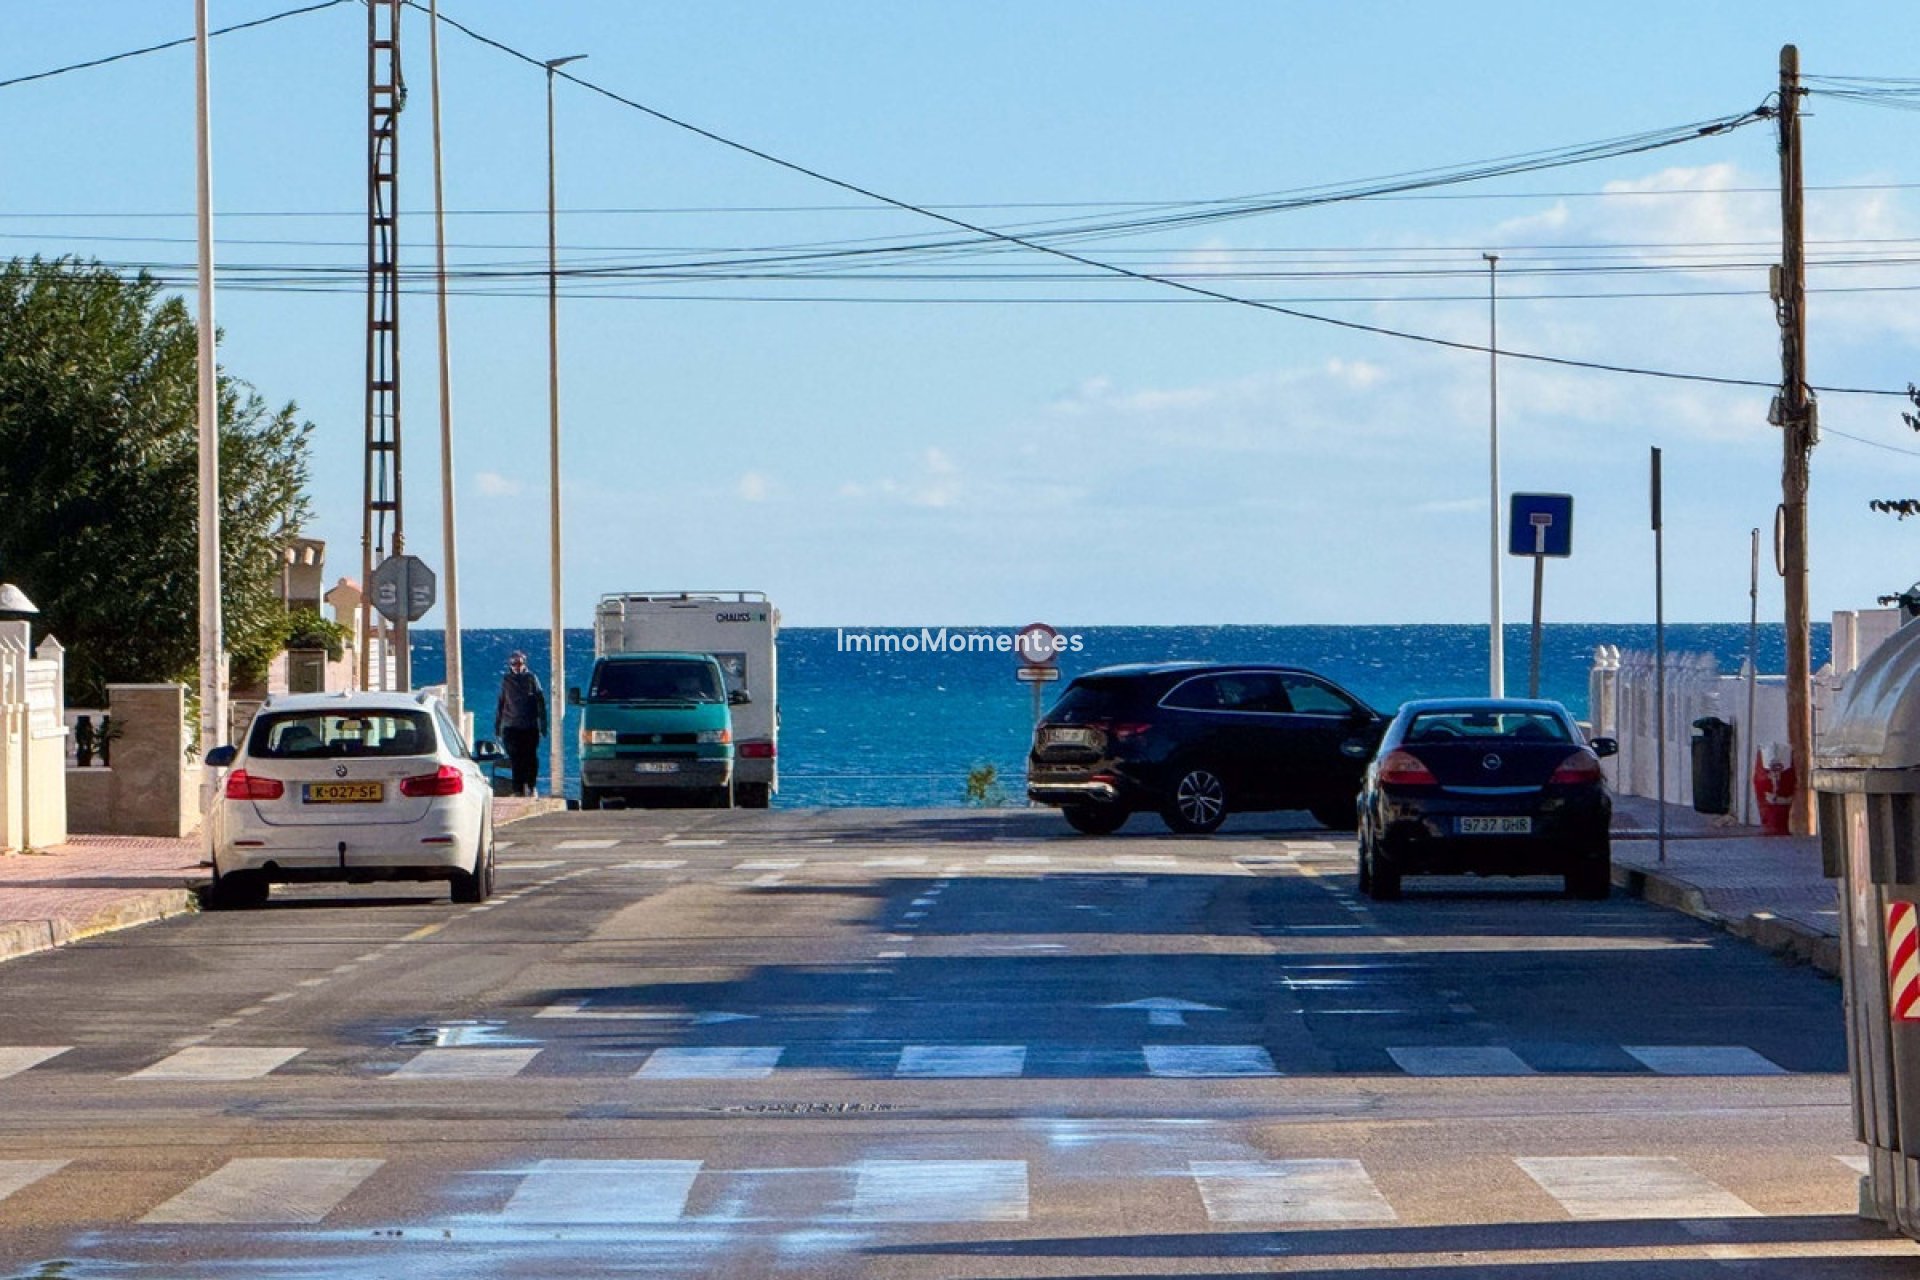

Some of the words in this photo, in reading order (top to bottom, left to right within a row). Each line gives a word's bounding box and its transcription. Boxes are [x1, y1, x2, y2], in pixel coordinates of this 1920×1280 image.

[716, 613, 767, 622] CHAUSSN
[316, 786, 377, 798] K-027-SF
[1463, 818, 1497, 831] 9737
